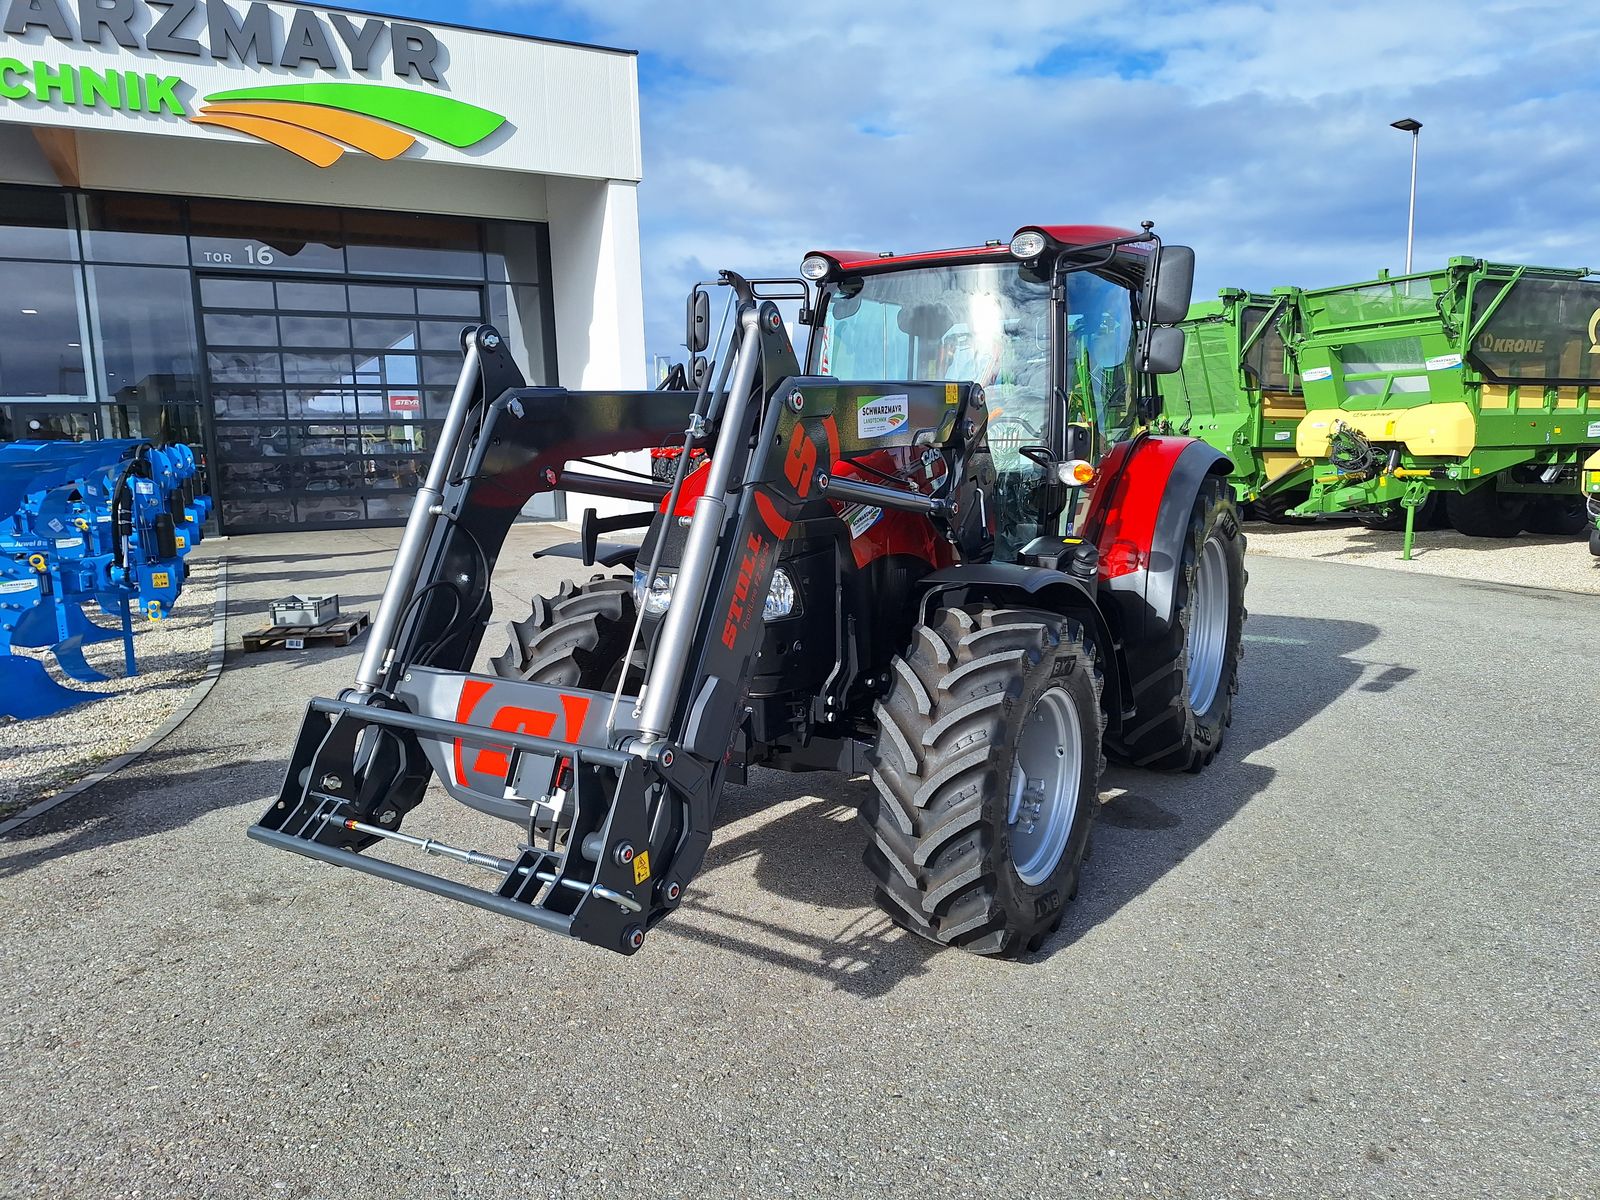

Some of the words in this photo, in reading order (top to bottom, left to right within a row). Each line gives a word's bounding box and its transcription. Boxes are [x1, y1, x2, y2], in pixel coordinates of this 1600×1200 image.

[4, 0, 440, 82] ARZMAYR
[0, 57, 187, 116] CHNIK
[204, 252, 232, 263] TOR
[244, 245, 274, 265] 16
[1493, 338, 1546, 353] KRONE
[862, 404, 902, 416] SCHWARZMAYR
[921, 447, 942, 466] CAS
[722, 531, 762, 651] STOLL
